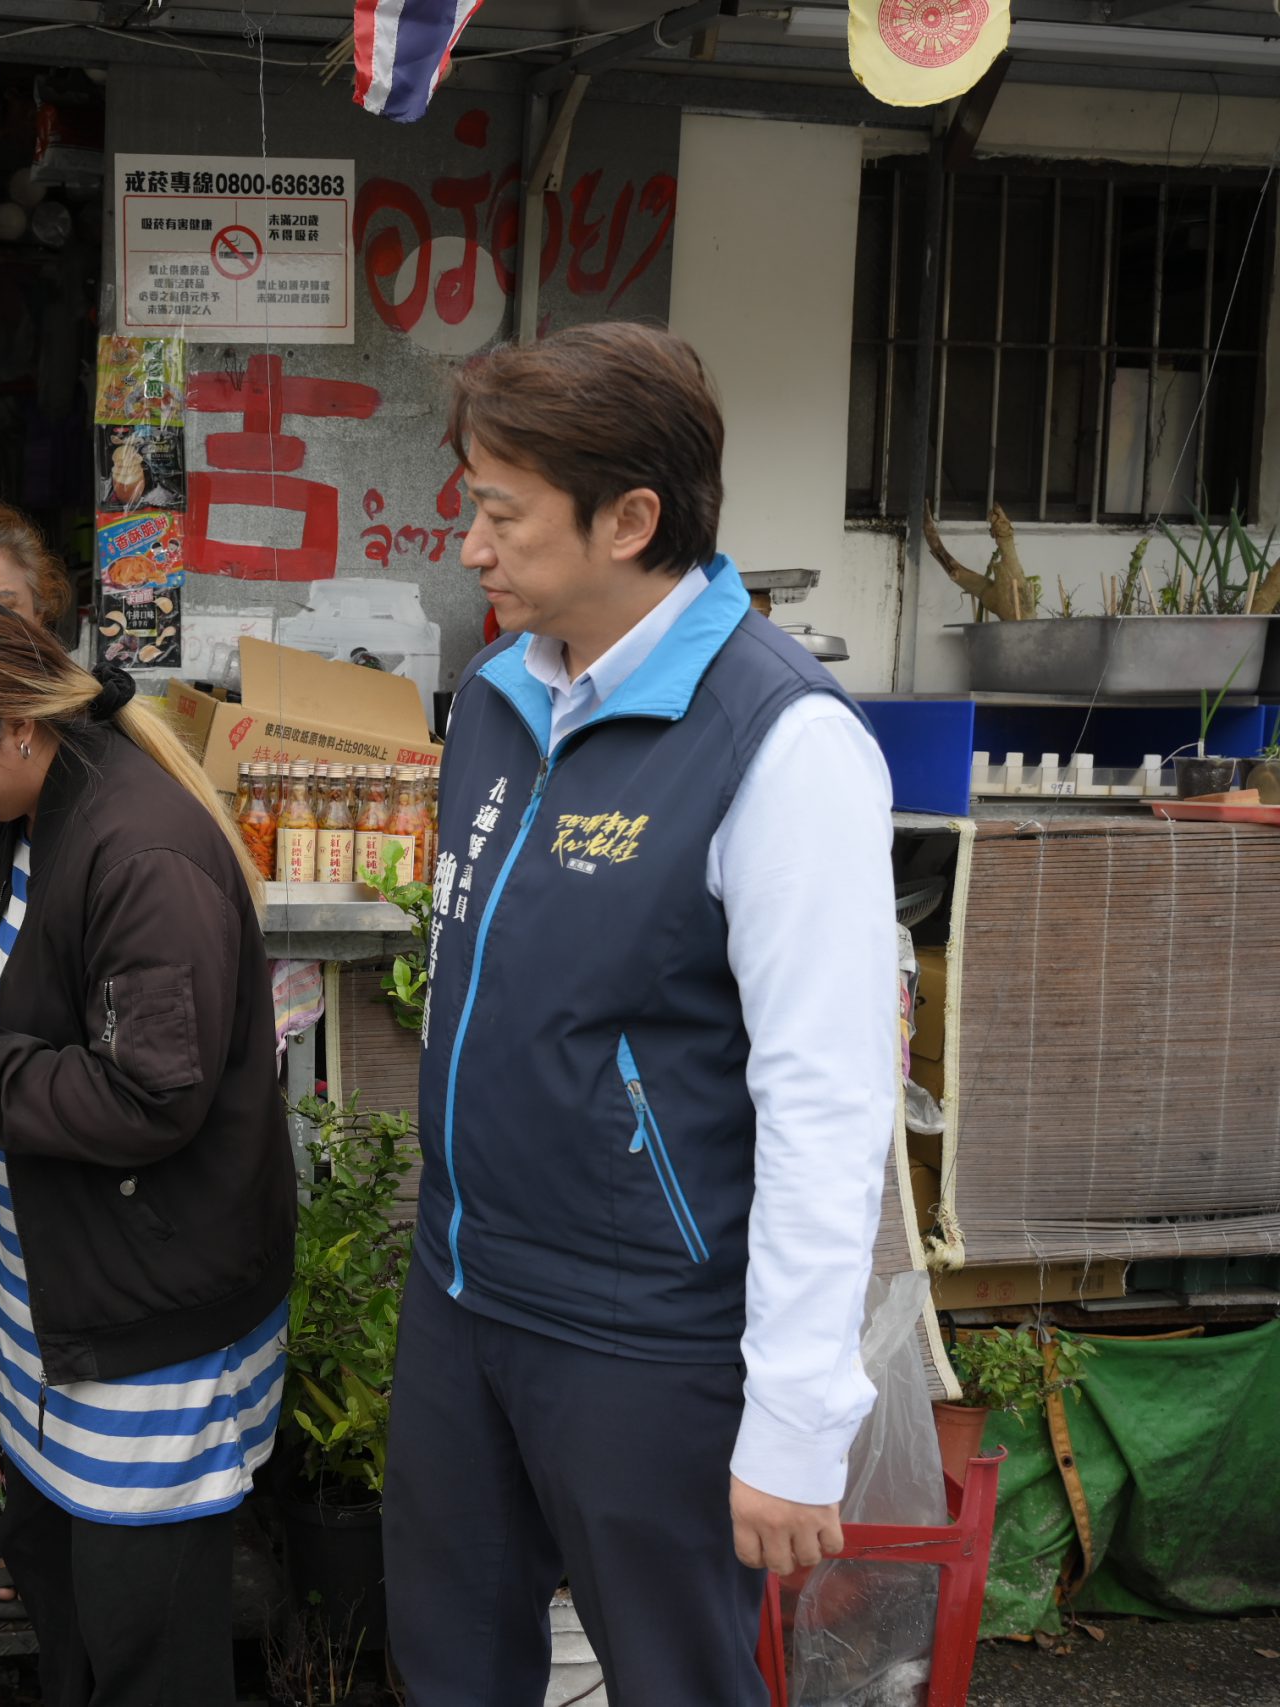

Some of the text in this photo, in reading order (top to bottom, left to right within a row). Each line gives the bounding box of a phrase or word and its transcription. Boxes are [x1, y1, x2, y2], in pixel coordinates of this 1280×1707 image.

[125, 170, 345, 196] 戒菸專線0800-636363
[141, 218, 213, 231] 吸菸有害健康
[268, 214, 319, 227] 未滿20歲
[268, 229, 319, 242] 不得吸菸
[452, 776, 508, 922] 花蓮縣議員
